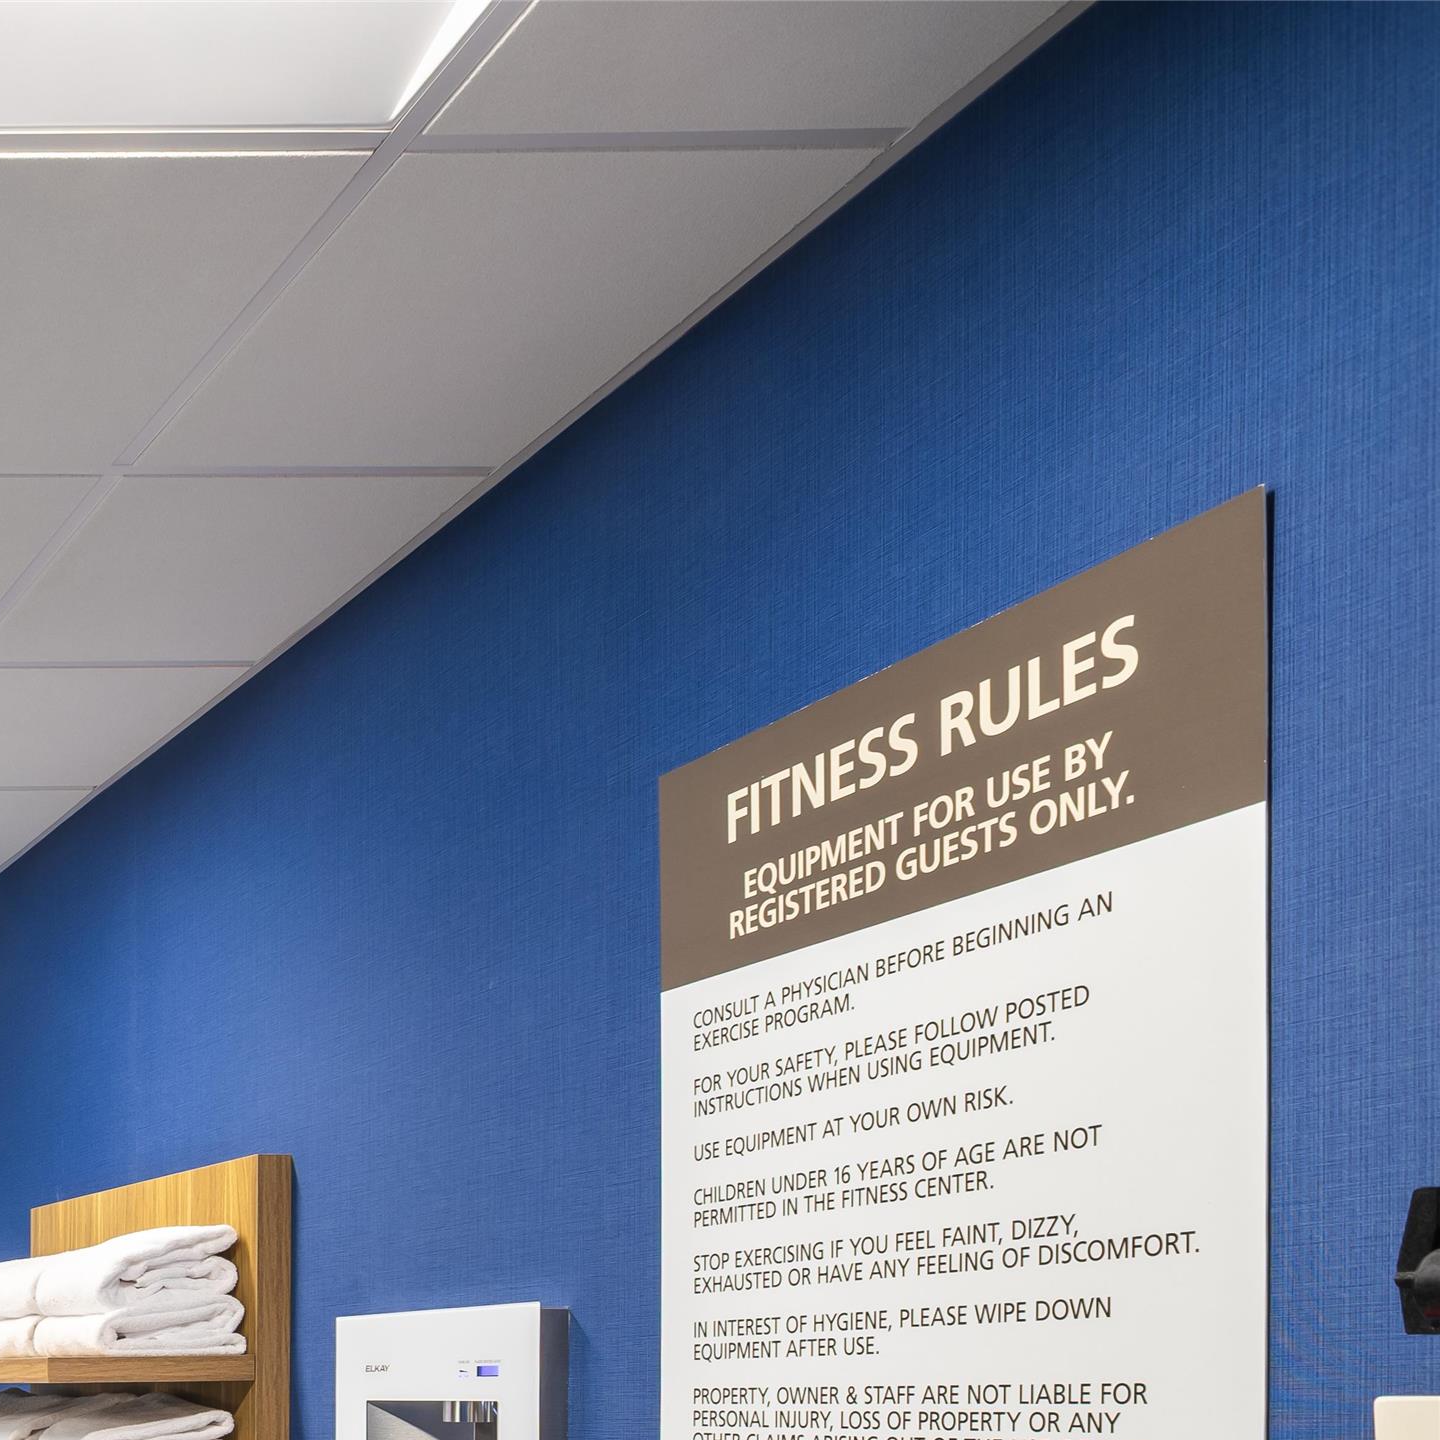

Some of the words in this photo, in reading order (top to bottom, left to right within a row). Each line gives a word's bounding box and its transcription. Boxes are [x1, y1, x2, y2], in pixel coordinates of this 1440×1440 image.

[727, 712, 918, 844] FITNESS
[939, 613, 1139, 757] RULES
[743, 810, 904, 899] EQUIPMENT
[913, 785, 976, 837] FOR
[986, 754, 1051, 809] USE
[1064, 729, 1113, 782] BY
[729, 860, 886, 940] REGISTERED
[895, 810, 1018, 881] GUESTS
[1029, 769, 1135, 835] ONLY.
[692, 994, 760, 1029] CONSULT
[763, 990, 777, 1010] A
[781, 962, 869, 1005] PHYSICIAN
[875, 939, 945, 978] BEFORE
[952, 903, 1069, 957] BEGINNING
[1077, 890, 1112, 921] AN
[693, 1017, 759, 1052] EXERCISE
[765, 992, 855, 1033] PROGRAM.
[693, 1073, 722, 1095] FOR
[726, 1061, 770, 1087] YOUR
[775, 1045, 838, 1077] SAFETY,
[845, 1027, 907, 1061] PLEASE
[914, 1005, 999, 1044] FOLLOW
[1005, 984, 1090, 1023] POSTED
[693, 1077, 802, 1118] INSTRUCTIONS
[807, 1064, 860, 1093] WHEN
[867, 1049, 922, 1080] USING
[929, 1020, 1055, 1067] EQUIPMENT.
[693, 1140, 720, 1162] USE
[725, 1121, 817, 1157] EQUIPMENT
[821, 1116, 844, 1139] AT
[848, 1106, 900, 1133] YOUR
[906, 1094, 956, 1123] OWN
[964, 1085, 1013, 1113] RISK.
[693, 1178, 765, 1206] CHILDREN
[771, 1168, 828, 1194] UNDER
[833, 1164, 851, 1185] 16
[856, 1153, 915, 1181] YEARS
[921, 1148, 947, 1172] OF
[953, 1141, 995, 1167] AGE
[1002, 1133, 1045, 1160] ARE
[1053, 1123, 1103, 1152] NOT
[693, 1200, 777, 1228] PERMITTED
[782, 1196, 798, 1217] IN
[803, 1191, 835, 1213] THE
[841, 1180, 908, 1209] FITNESS
[914, 1169, 994, 1199] CENTER.
[693, 1252, 730, 1273] STOP
[734, 1241, 824, 1268] EXERCISING
[830, 1239, 844, 1258] IF
[848, 1234, 888, 1256] YOU
[895, 1229, 936, 1252] FEEL
[942, 1221, 1003, 1247] FAINT,
[1011, 1213, 1079, 1241] DIZZY,
[693, 1269, 782, 1295] EXHAUSTED
[787, 1267, 811, 1287] OR
[817, 1261, 863, 1284] HAVE
[869, 1257, 910, 1280] ANY
[916, 1249, 994, 1276] FEELING
[1001, 1246, 1030, 1269] OF
[1038, 1230, 1200, 1266] DISCOMFORT.
[693, 1321, 707, 1338] IN
[712, 1316, 781, 1337] INTEREST
[785, 1314, 808, 1334] OF
[813, 1309, 892, 1332] HYGIENE,
[899, 1304, 968, 1328] PLEASE
[973, 1301, 1027, 1324] WIPE
[1035, 1296, 1111, 1321] DOWN
[693, 1339, 782, 1363] EQUIPMENT
[785, 1337, 837, 1357] AFTER
[843, 1335, 880, 1356] USE.
[365, 1364, 391, 1373] ELKAY
[693, 1386, 770, 1407] PROPERTY,
[776, 1386, 839, 1405] OWNER
[845, 1385, 858, 1405] &
[864, 1385, 915, 1405] STAFF
[920, 1384, 959, 1405] ARE
[967, 1383, 1012, 1405] NOT
[1019, 1382, 1091, 1405] LIABLE
[1100, 1382, 1148, 1405] FOR
[692, 1409, 770, 1428] PERSONAL
[774, 1410, 833, 1432] INJURY,
[840, 1410, 881, 1430] LOSS
[886, 1410, 911, 1430] OF
[918, 1410, 1022, 1432] PROPERTY
[1028, 1411, 1061, 1433] OR
[1067, 1411, 1121, 1434] ANY
